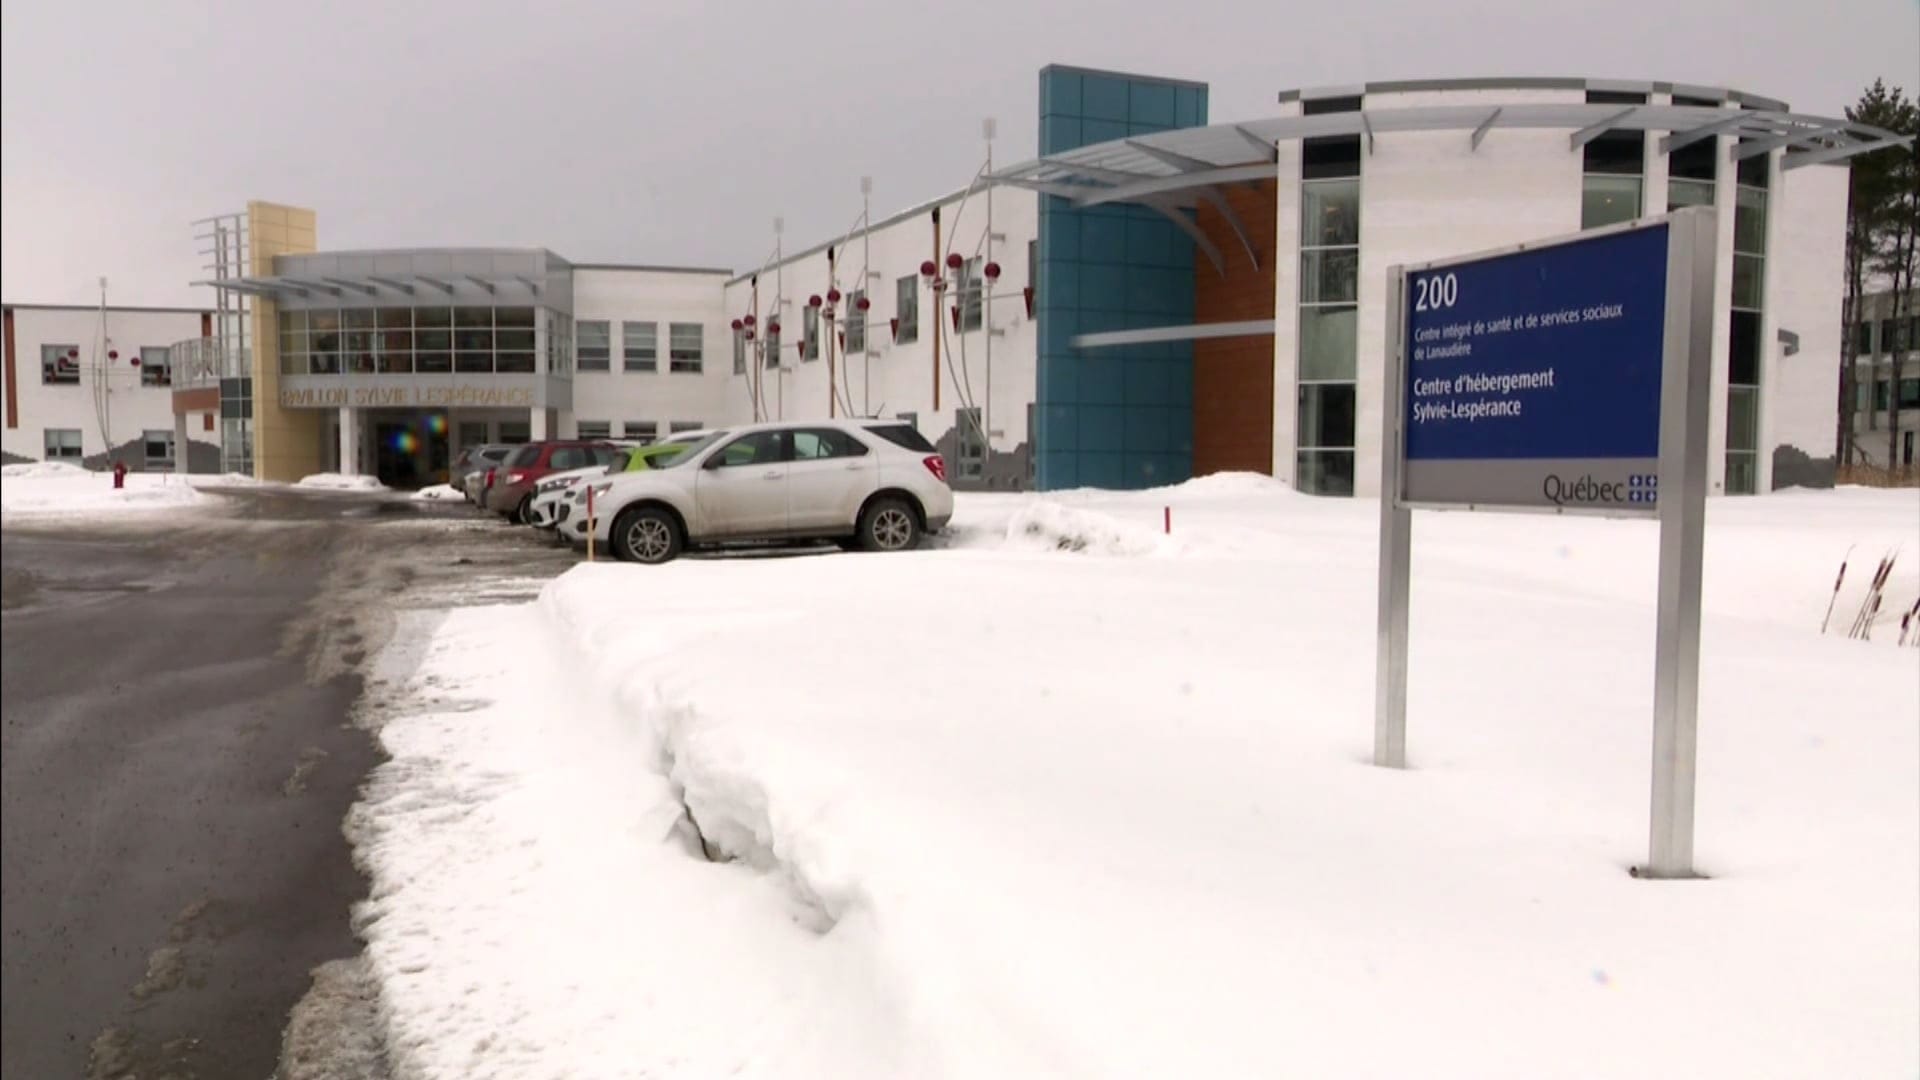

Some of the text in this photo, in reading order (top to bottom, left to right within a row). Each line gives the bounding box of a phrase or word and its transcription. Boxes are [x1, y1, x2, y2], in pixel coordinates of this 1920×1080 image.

[1415, 273, 1458, 312] 200
[1414, 303, 1623, 343] Centre intégré de santé et de services sociaux
[1414, 347, 1425, 361] de
[282, 385, 535, 405] PAVILLON SYLVIE LESPÉRANCE
[1414, 367, 1555, 397] Centre d'hébergement
[1413, 398, 1521, 424] Sylvie-Lespérance
[1543, 474, 1624, 505] Québec
